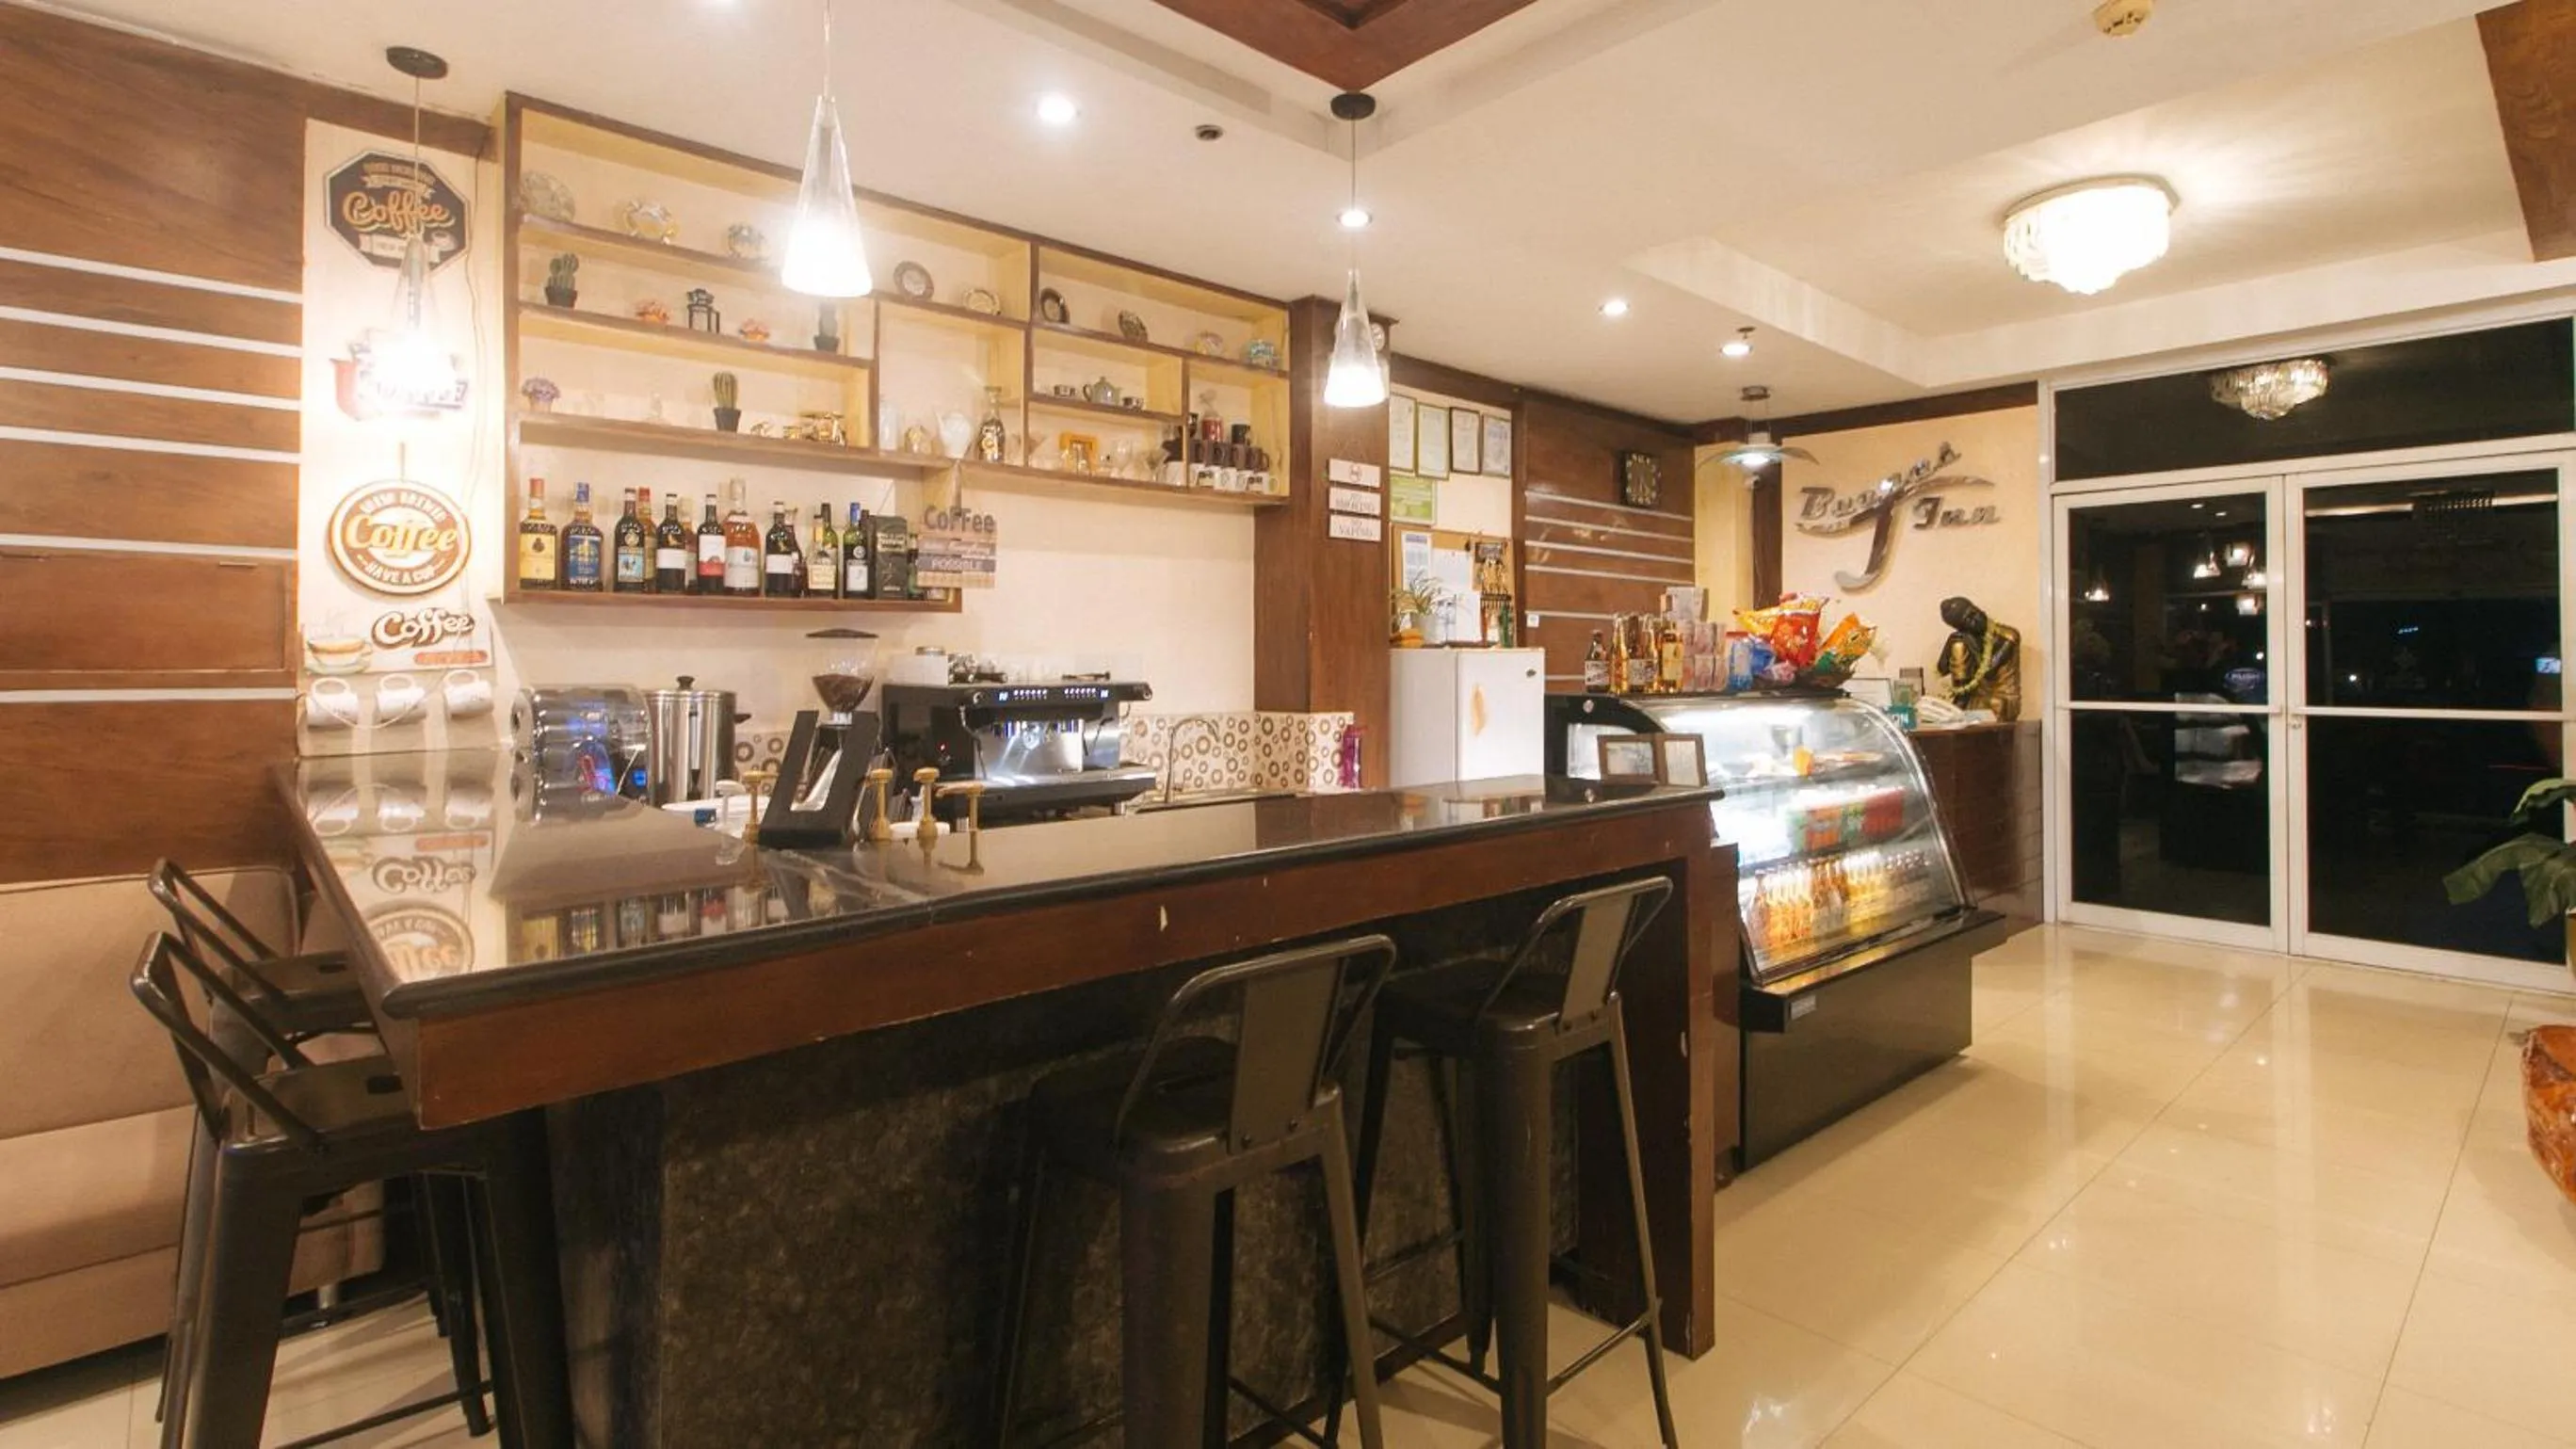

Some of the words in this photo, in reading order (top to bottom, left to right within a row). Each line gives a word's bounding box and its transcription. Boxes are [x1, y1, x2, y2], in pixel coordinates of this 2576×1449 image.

[342, 190, 451, 234] Coffee
[1912, 495, 2001, 530] Inn
[345, 513, 458, 557] Coffee
[373, 607, 475, 650] Coffee
